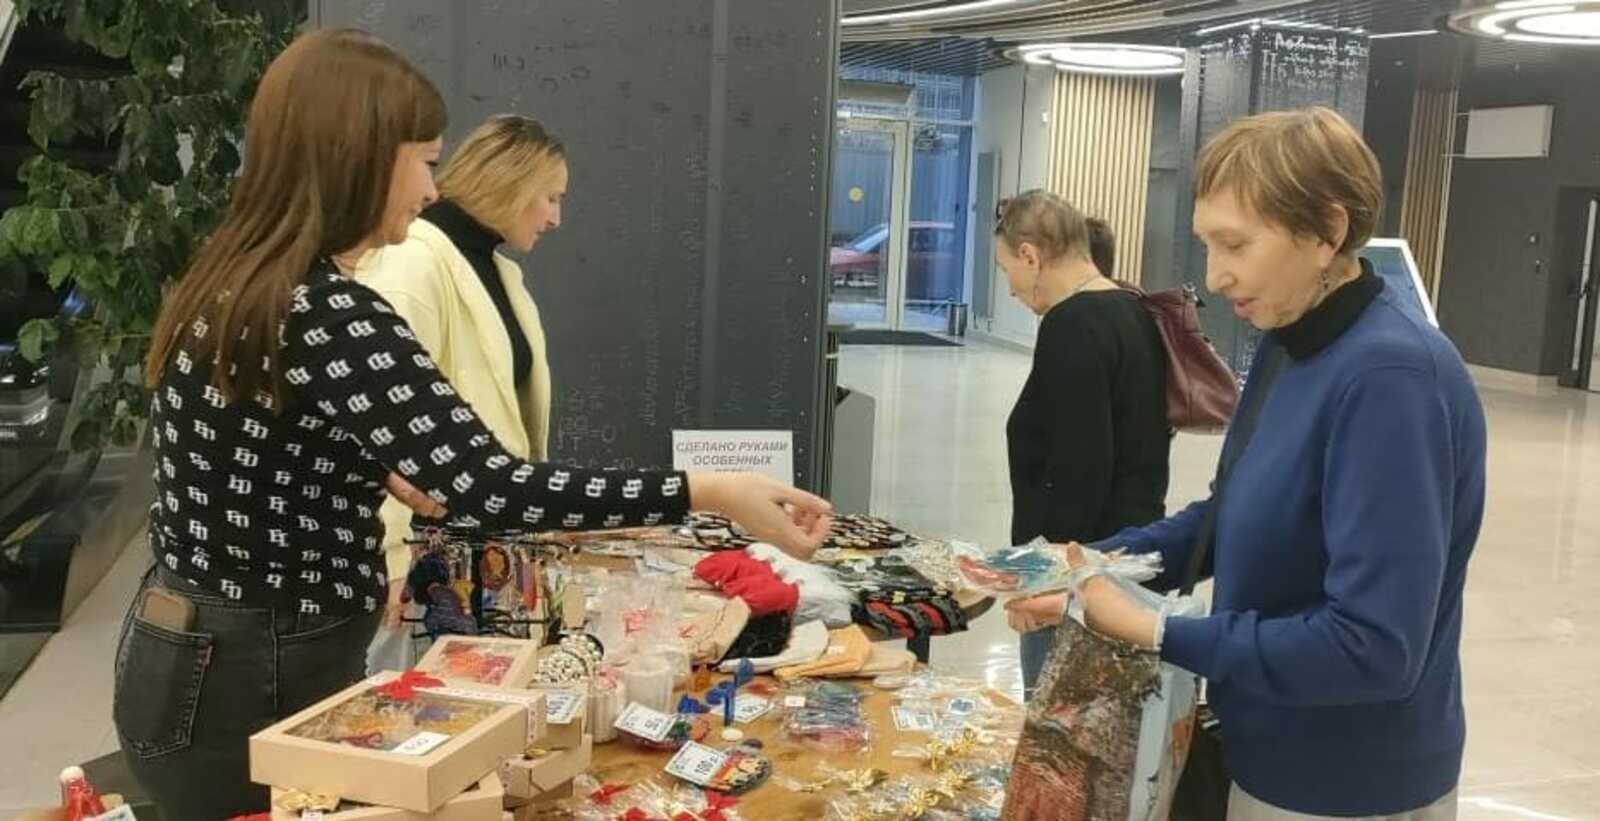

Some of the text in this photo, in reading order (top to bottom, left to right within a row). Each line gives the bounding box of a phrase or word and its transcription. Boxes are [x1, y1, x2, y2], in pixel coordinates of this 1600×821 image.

[676, 440, 788, 453] СДЕЛАНО РУКАМИ
[692, 455, 773, 466] ОСОБЕННЫХ
